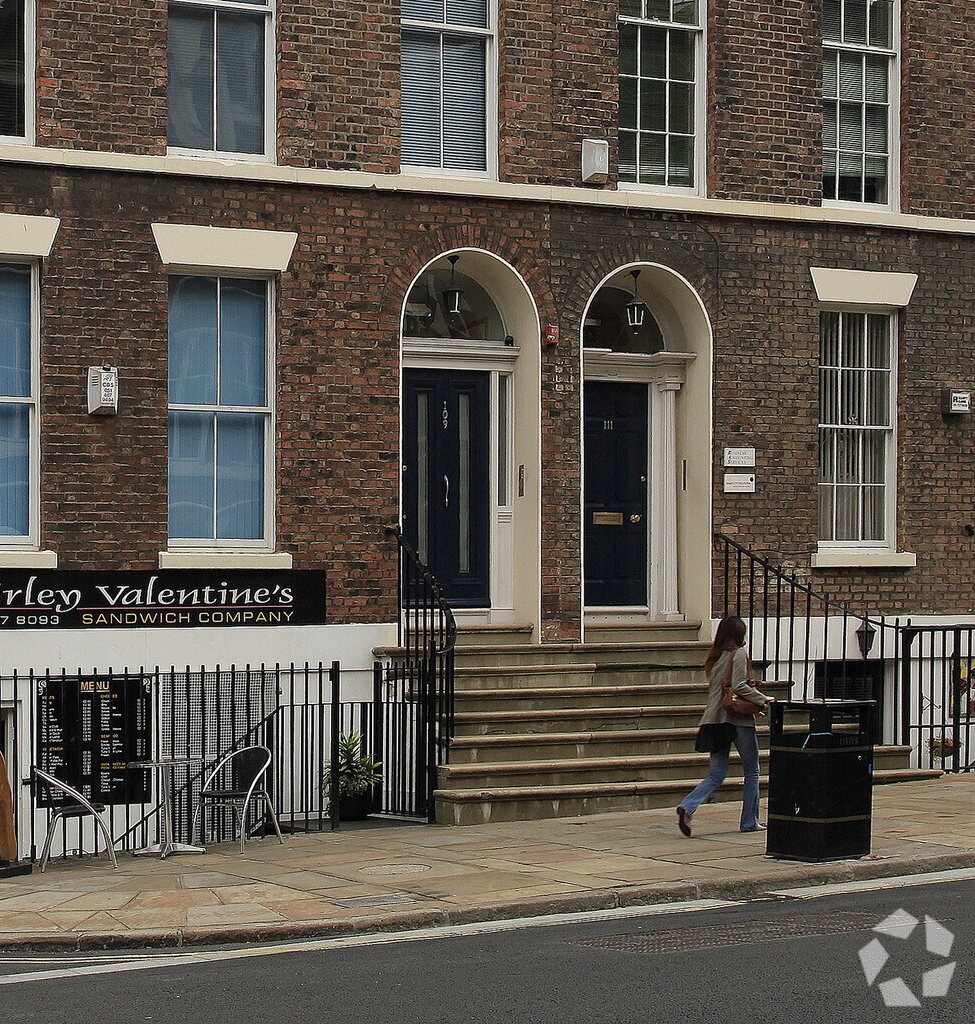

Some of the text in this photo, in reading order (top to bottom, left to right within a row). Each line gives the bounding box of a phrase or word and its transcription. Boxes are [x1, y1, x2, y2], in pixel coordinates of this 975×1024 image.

[95, 576, 294, 606] Valentine's
[16, 615, 60, 625] 8093
[82, 611, 294, 625] SANDWICH COMPANY
[80, 681, 110, 691] MENU
